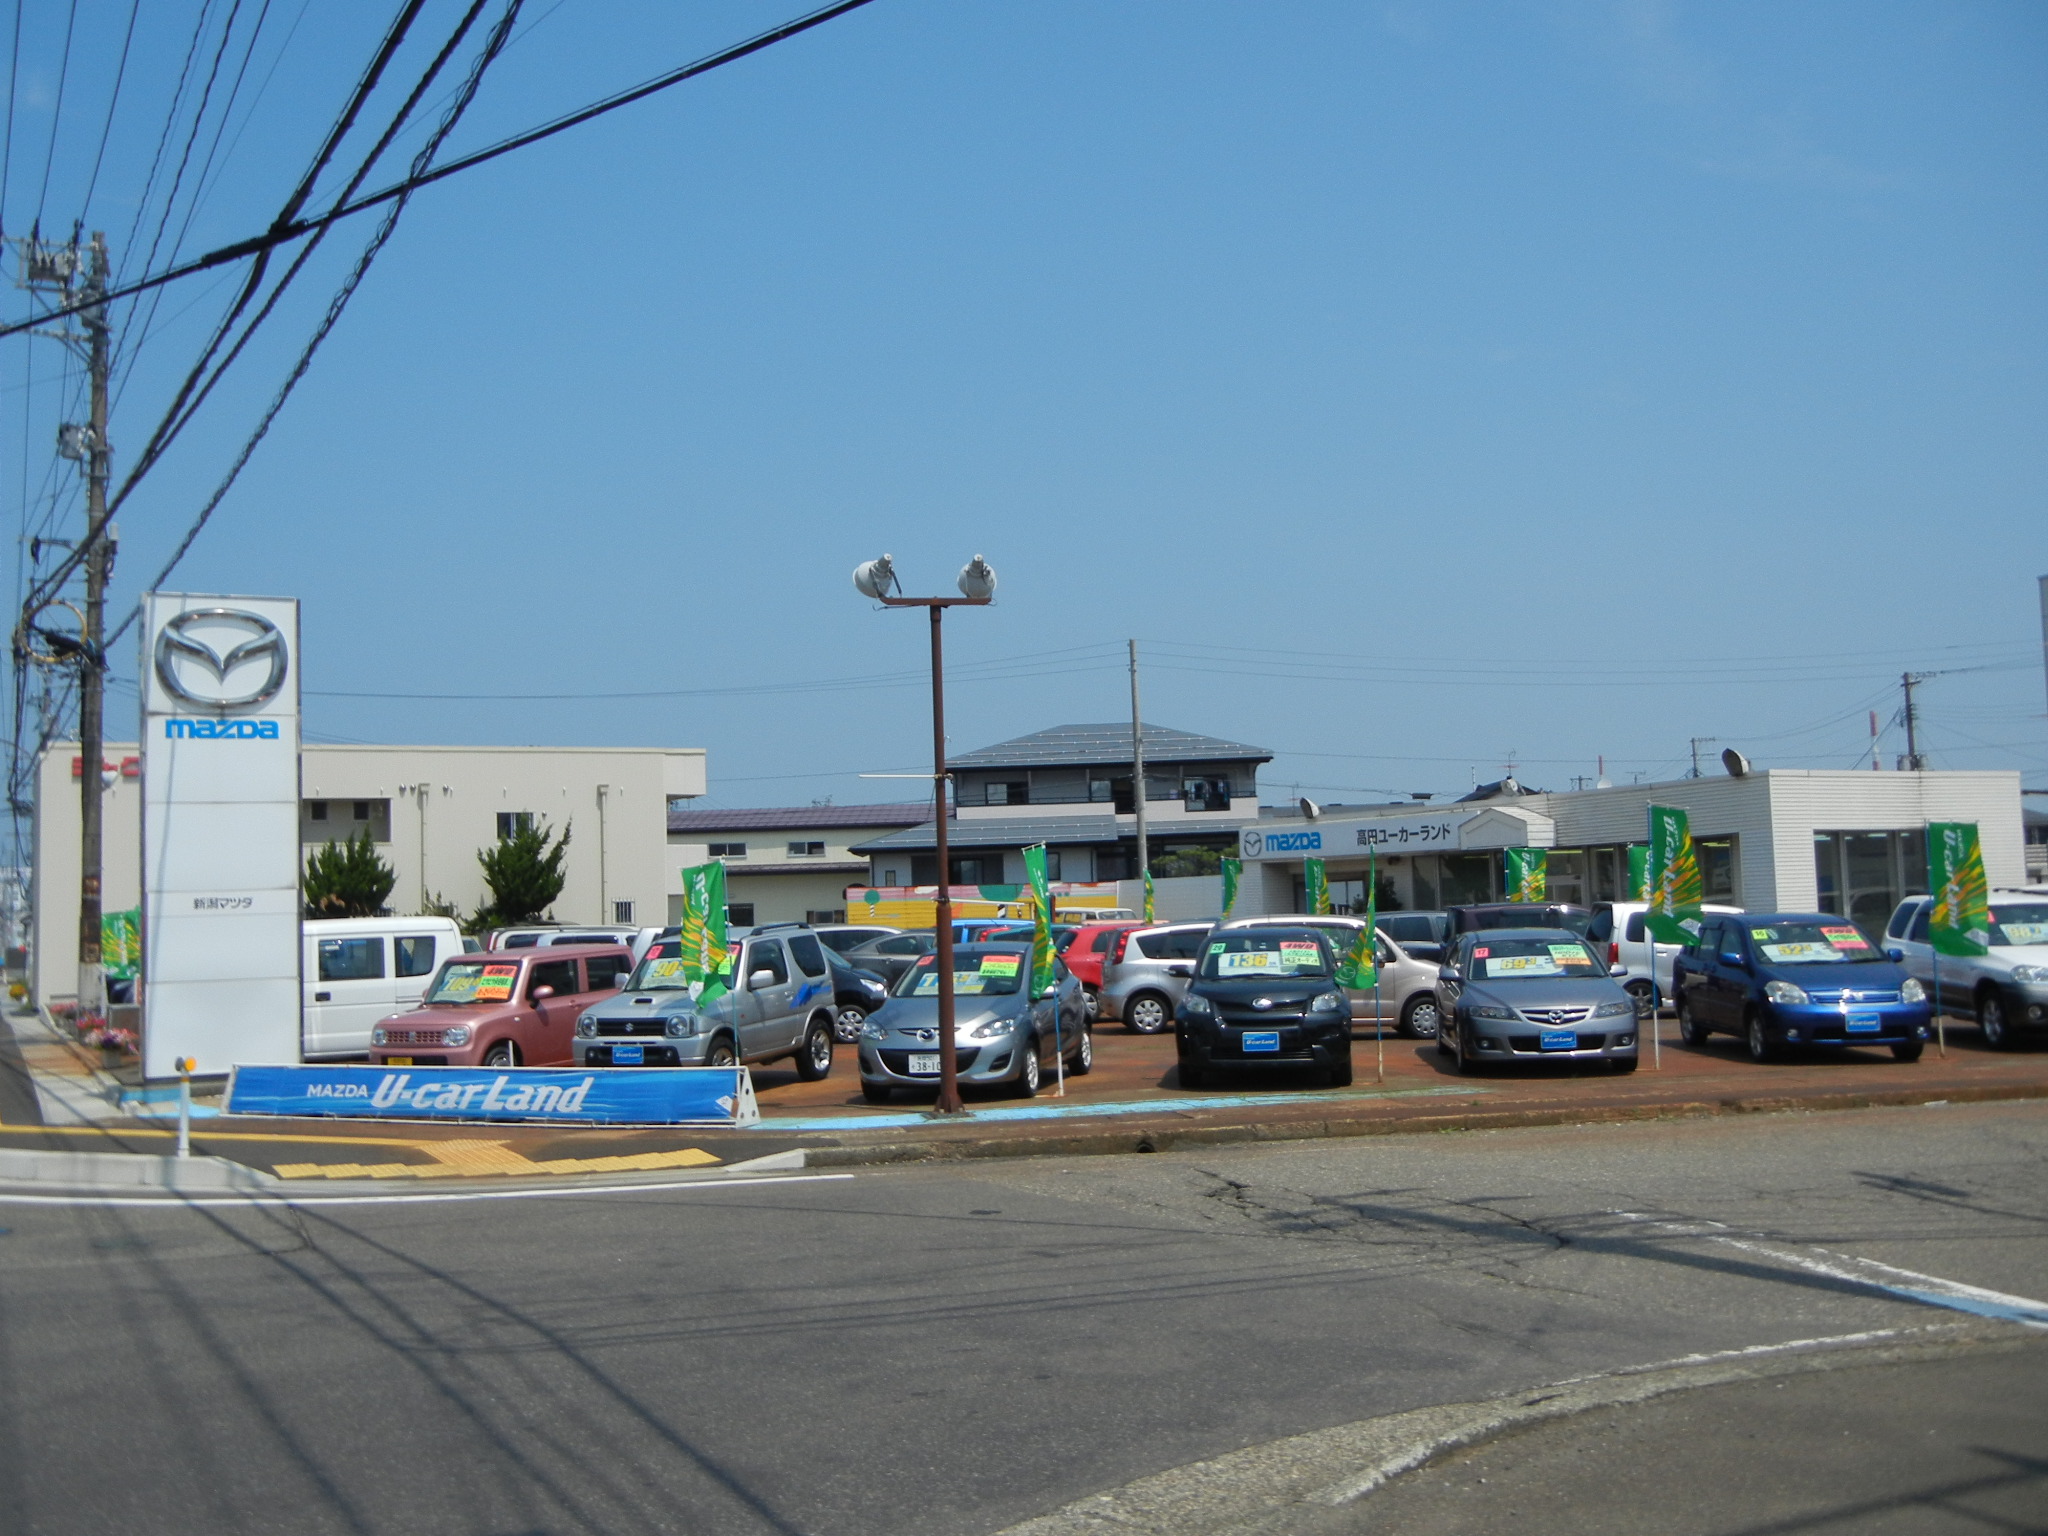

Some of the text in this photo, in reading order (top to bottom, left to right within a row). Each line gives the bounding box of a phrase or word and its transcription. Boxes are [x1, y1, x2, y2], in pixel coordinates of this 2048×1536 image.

[1356, 823, 1451, 846] 高田ユーカーランド
[194, 897, 254, 910] 新潟マツダ
[1229, 954, 1268, 967] 136
[306, 1084, 369, 1098] MAZDA
